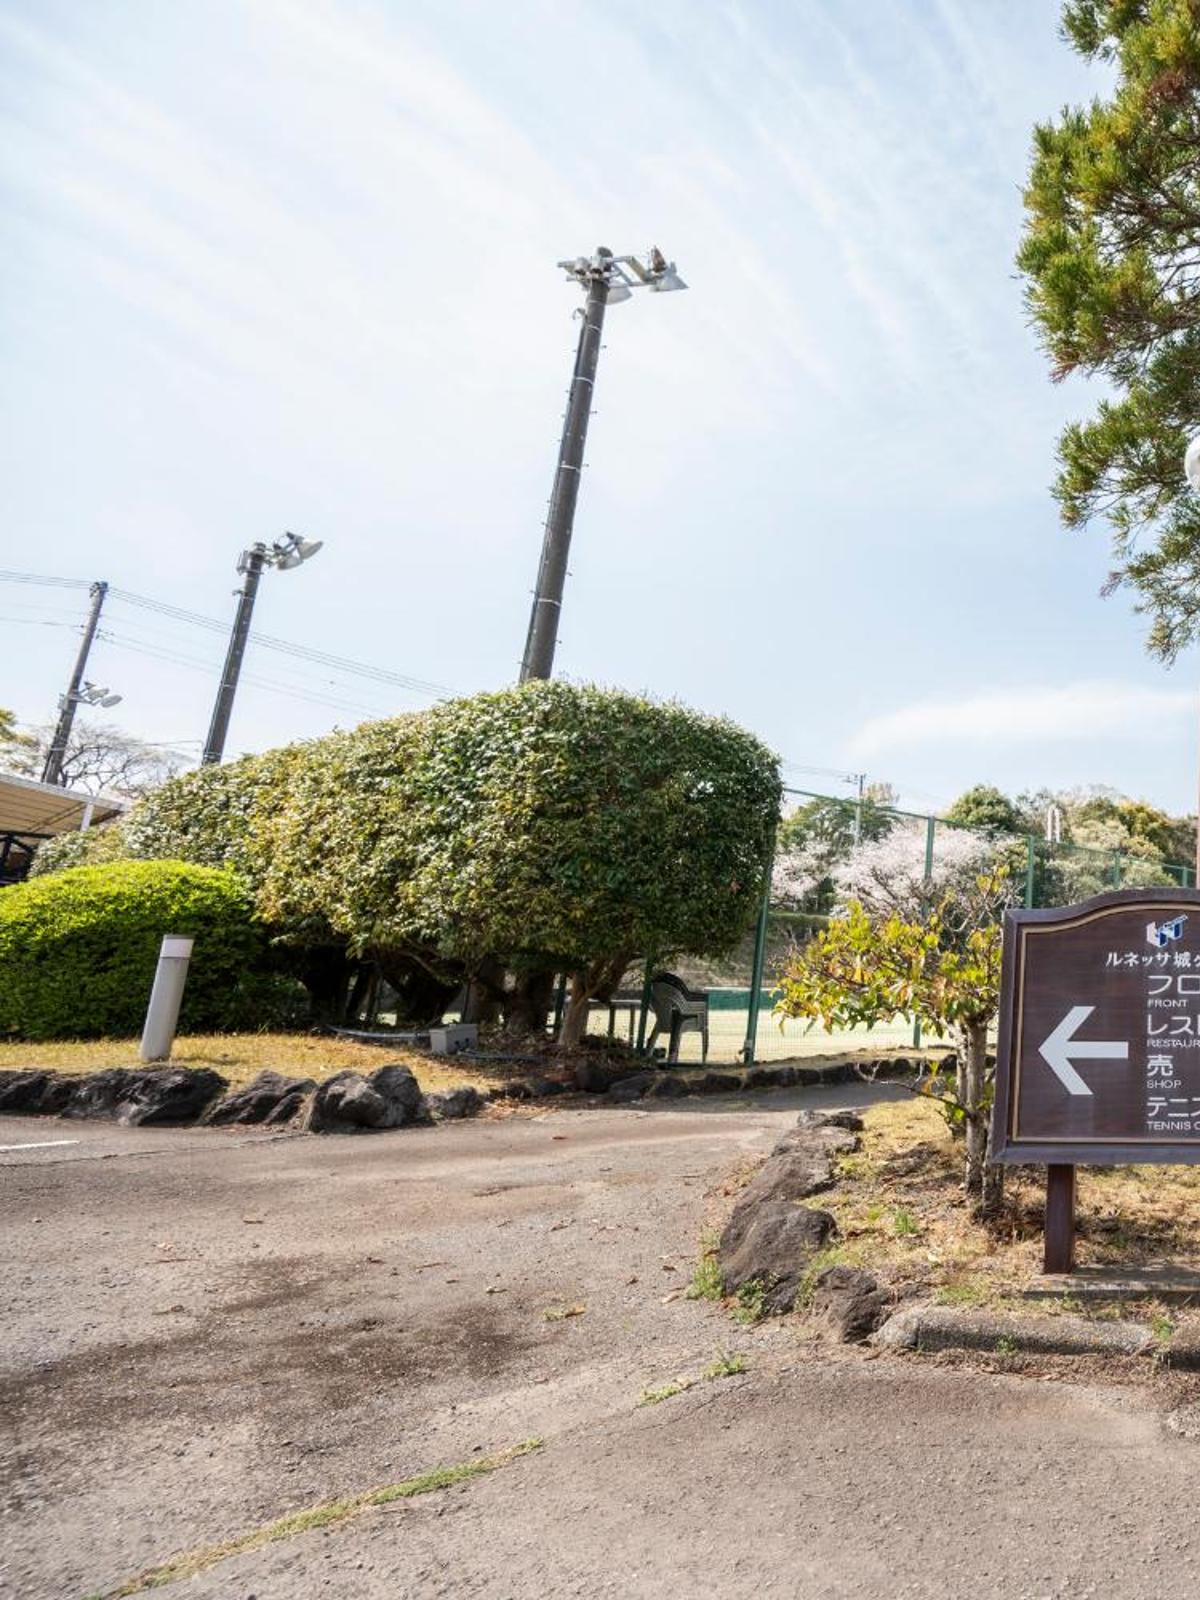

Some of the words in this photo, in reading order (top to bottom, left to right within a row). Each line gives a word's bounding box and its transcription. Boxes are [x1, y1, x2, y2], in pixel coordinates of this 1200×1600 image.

[1147, 999, 1188, 1008] FRONT
[1146, 1079, 1182, 1089] SHOP
[1147, 1120, 1191, 1131] TENNIS
